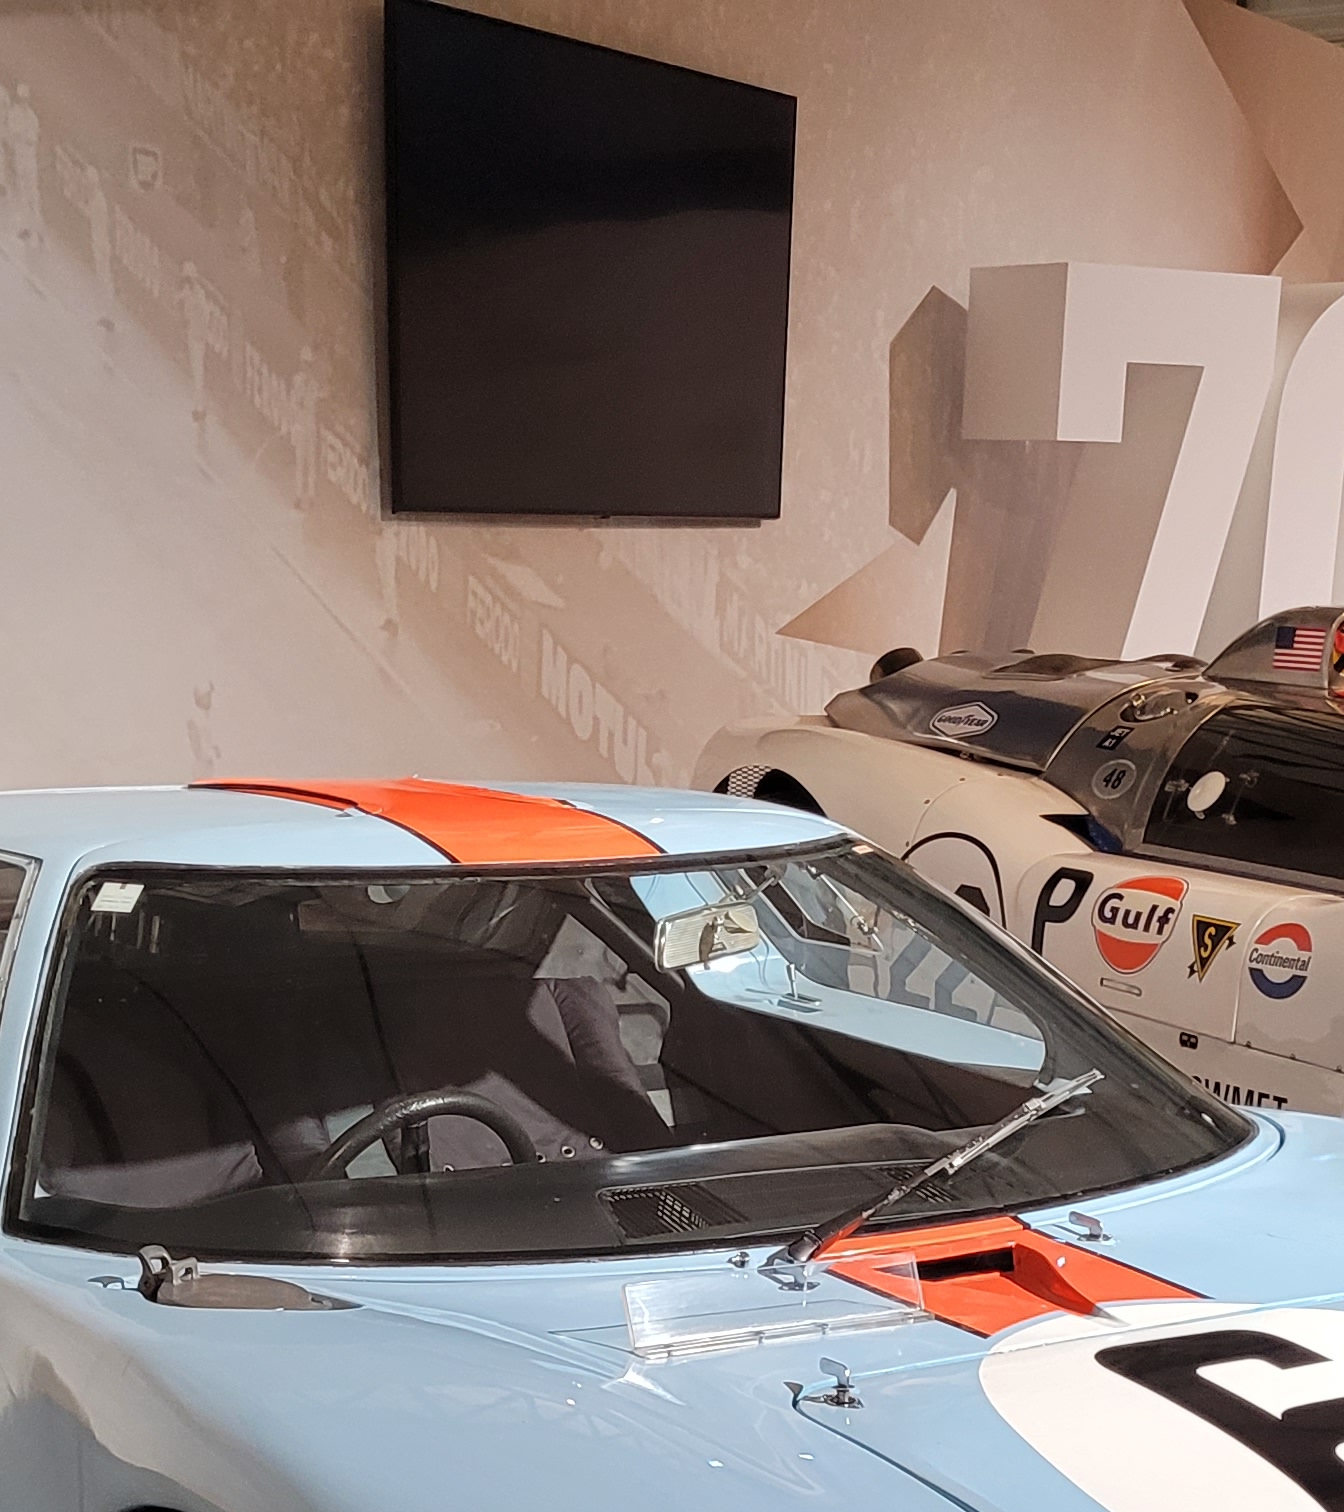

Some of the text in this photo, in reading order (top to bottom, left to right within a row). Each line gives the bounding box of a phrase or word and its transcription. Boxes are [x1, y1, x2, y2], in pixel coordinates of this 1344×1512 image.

[542, 627, 656, 784] MOTUL
[1102, 767, 1127, 790] 48
[1031, 866, 1094, 958] P
[1097, 891, 1176, 938] Gulf
[1199, 925, 1216, 959] S
[1248, 946, 1311, 973] Continental
